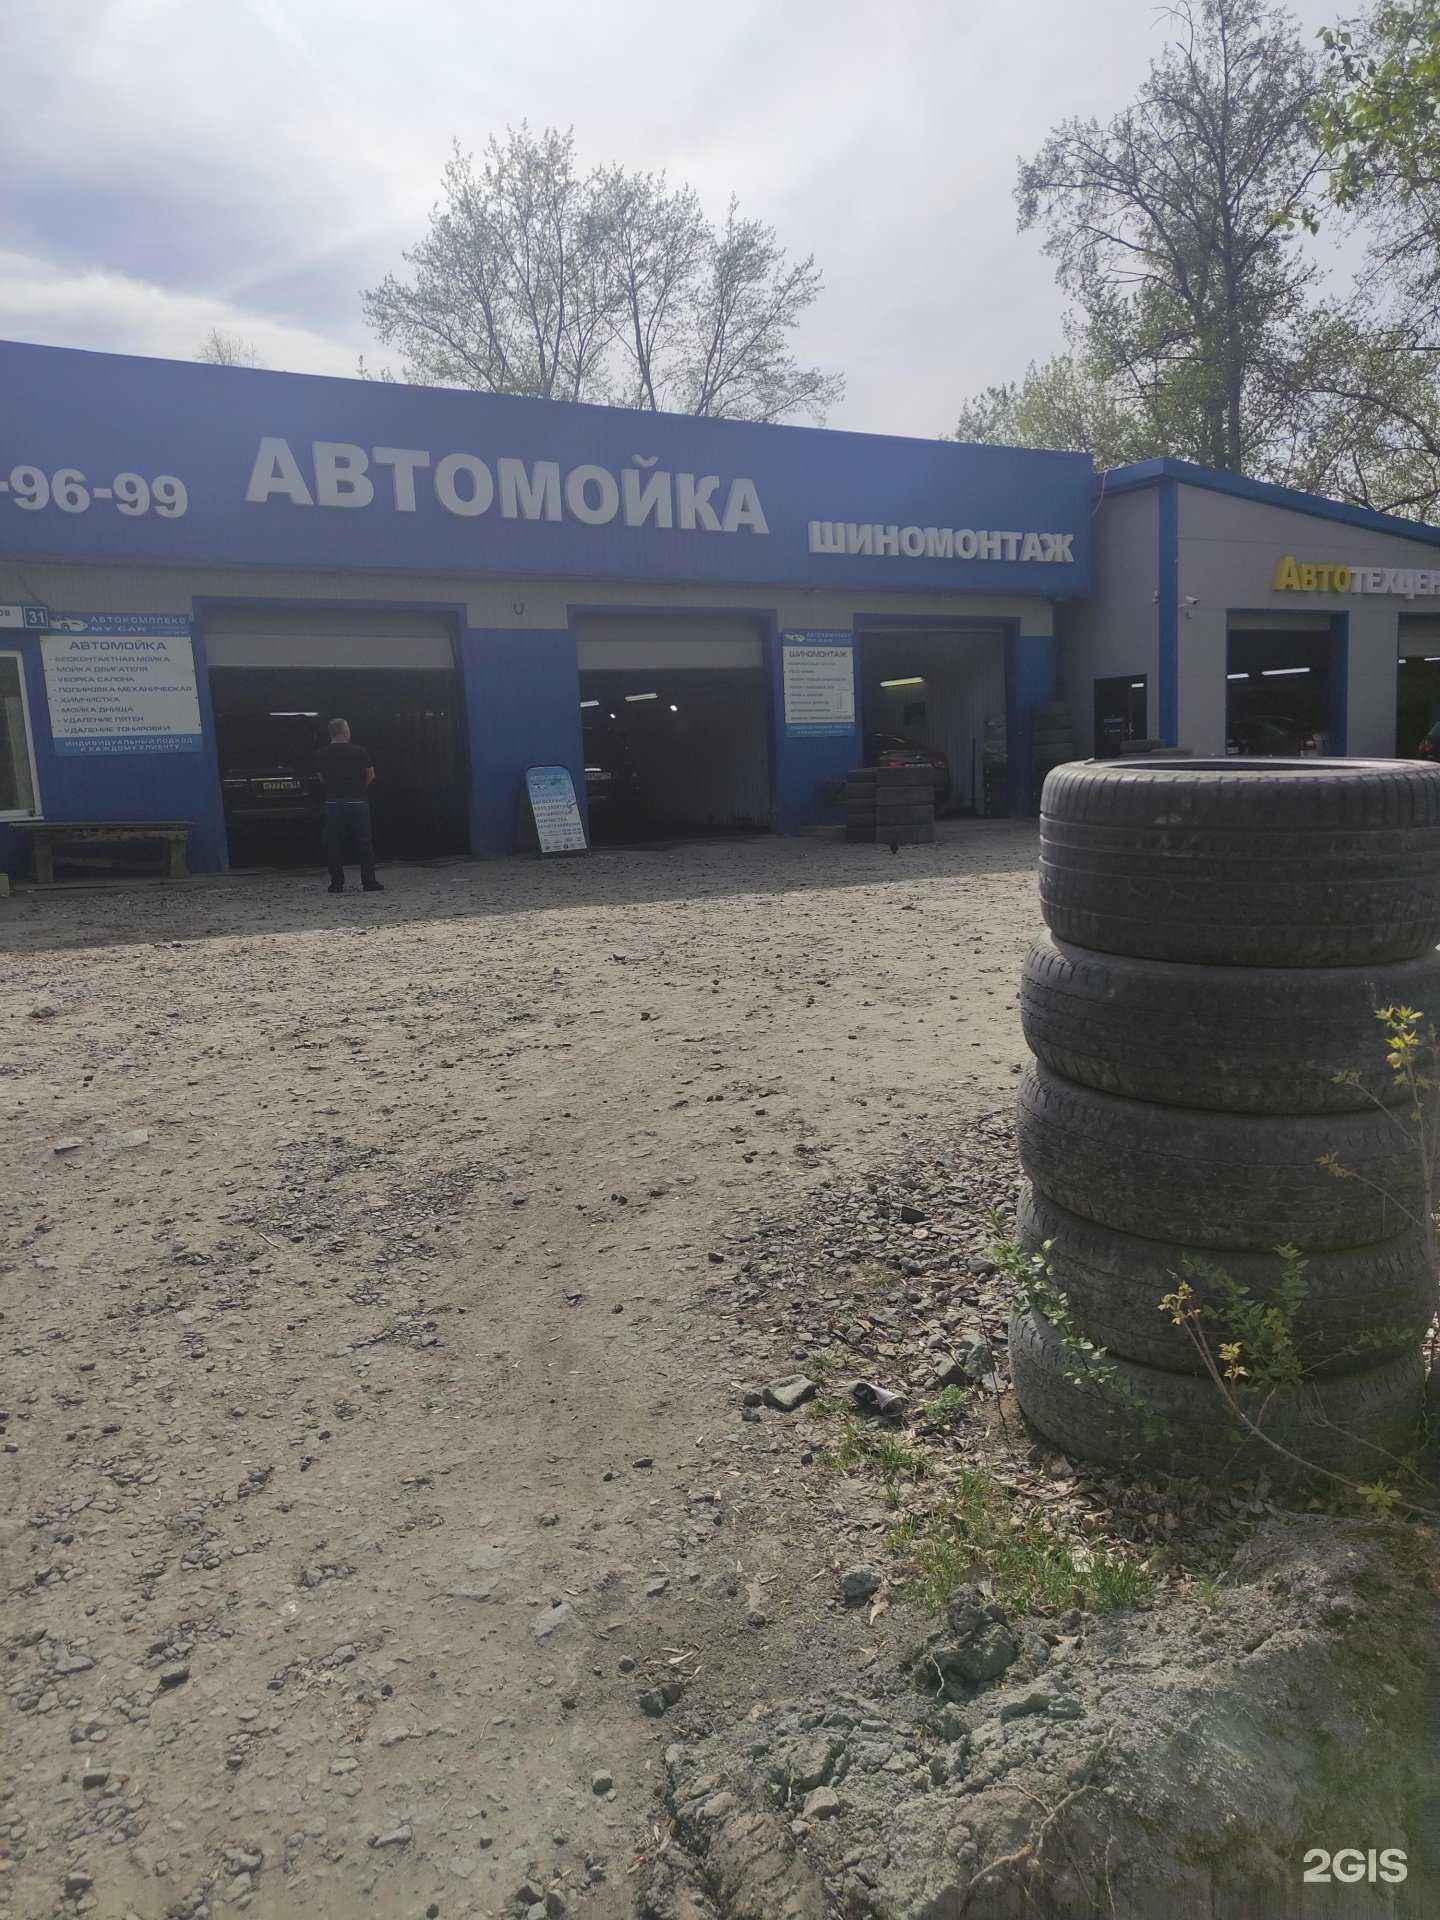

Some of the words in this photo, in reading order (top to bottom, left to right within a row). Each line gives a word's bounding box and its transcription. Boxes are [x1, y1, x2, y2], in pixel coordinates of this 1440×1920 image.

[246, 436, 769, 535] АВТОМОЙКА
[808, 520, 1075, 565] ШИНОМОНТАЖ
[29, 610, 46, 624] 31
[69, 640, 167, 651] АВТОМОЙКА
[789, 650, 847, 658] ШИНОМОНТАЖ
